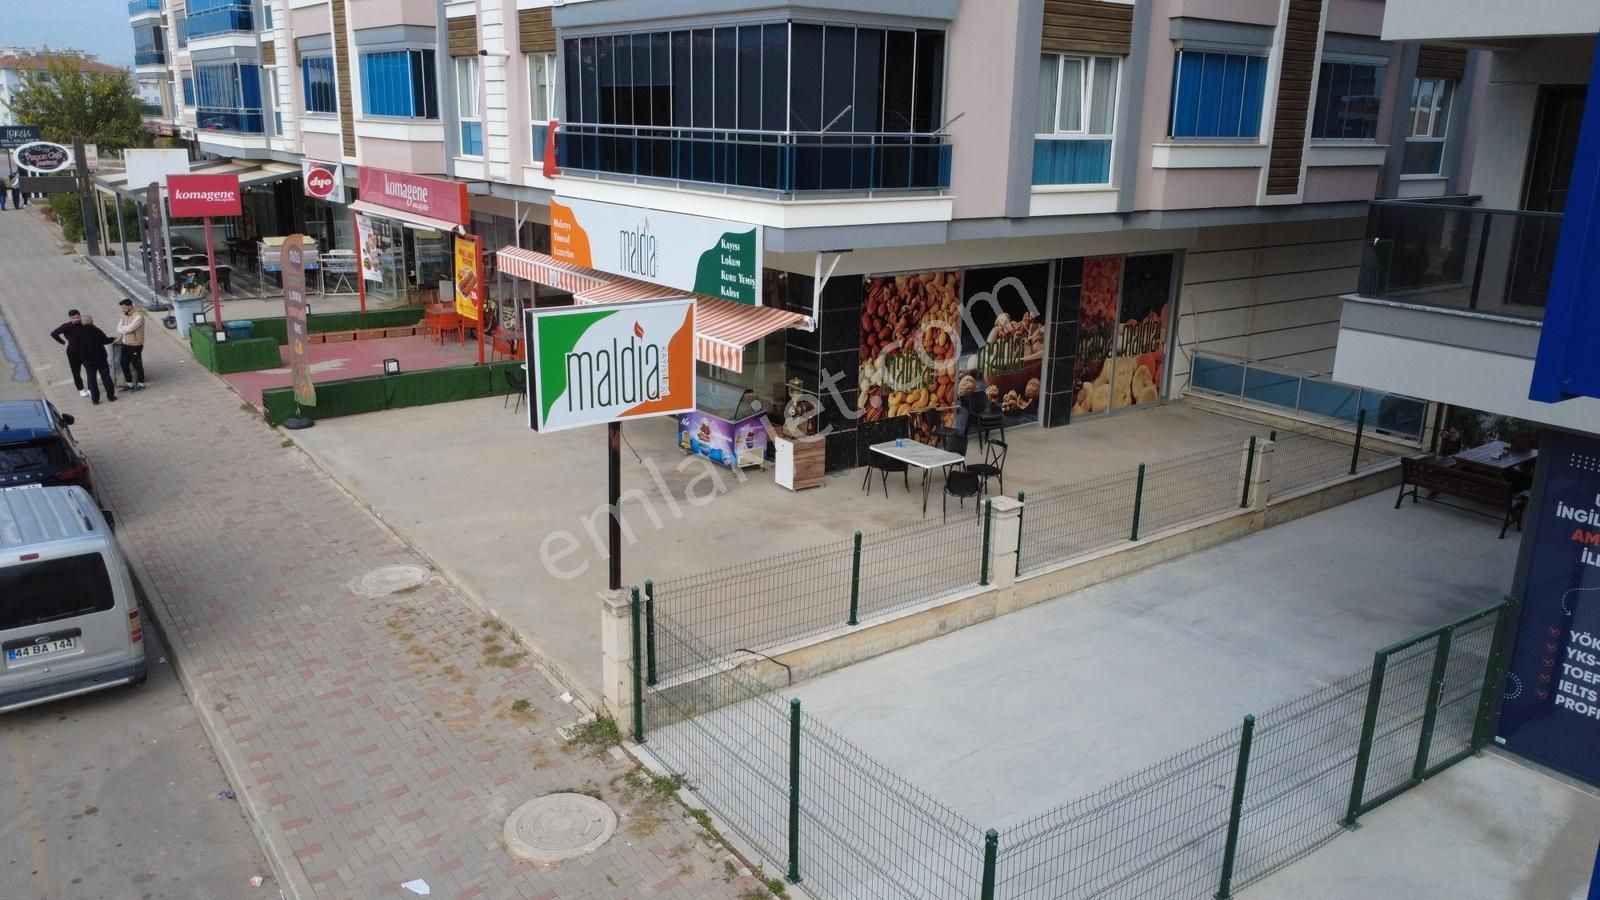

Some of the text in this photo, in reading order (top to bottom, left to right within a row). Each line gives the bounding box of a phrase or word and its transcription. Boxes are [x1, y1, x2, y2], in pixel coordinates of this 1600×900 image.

[309, 176, 332, 189] dyo
[384, 172, 428, 207] komagene
[175, 189, 235, 202] komagene
[620, 225, 656, 278] maldia
[566, 335, 660, 412] maldia
[16, 639, 73, 657] 44 BA 144
[1558, 679, 1598, 702] IELTS
